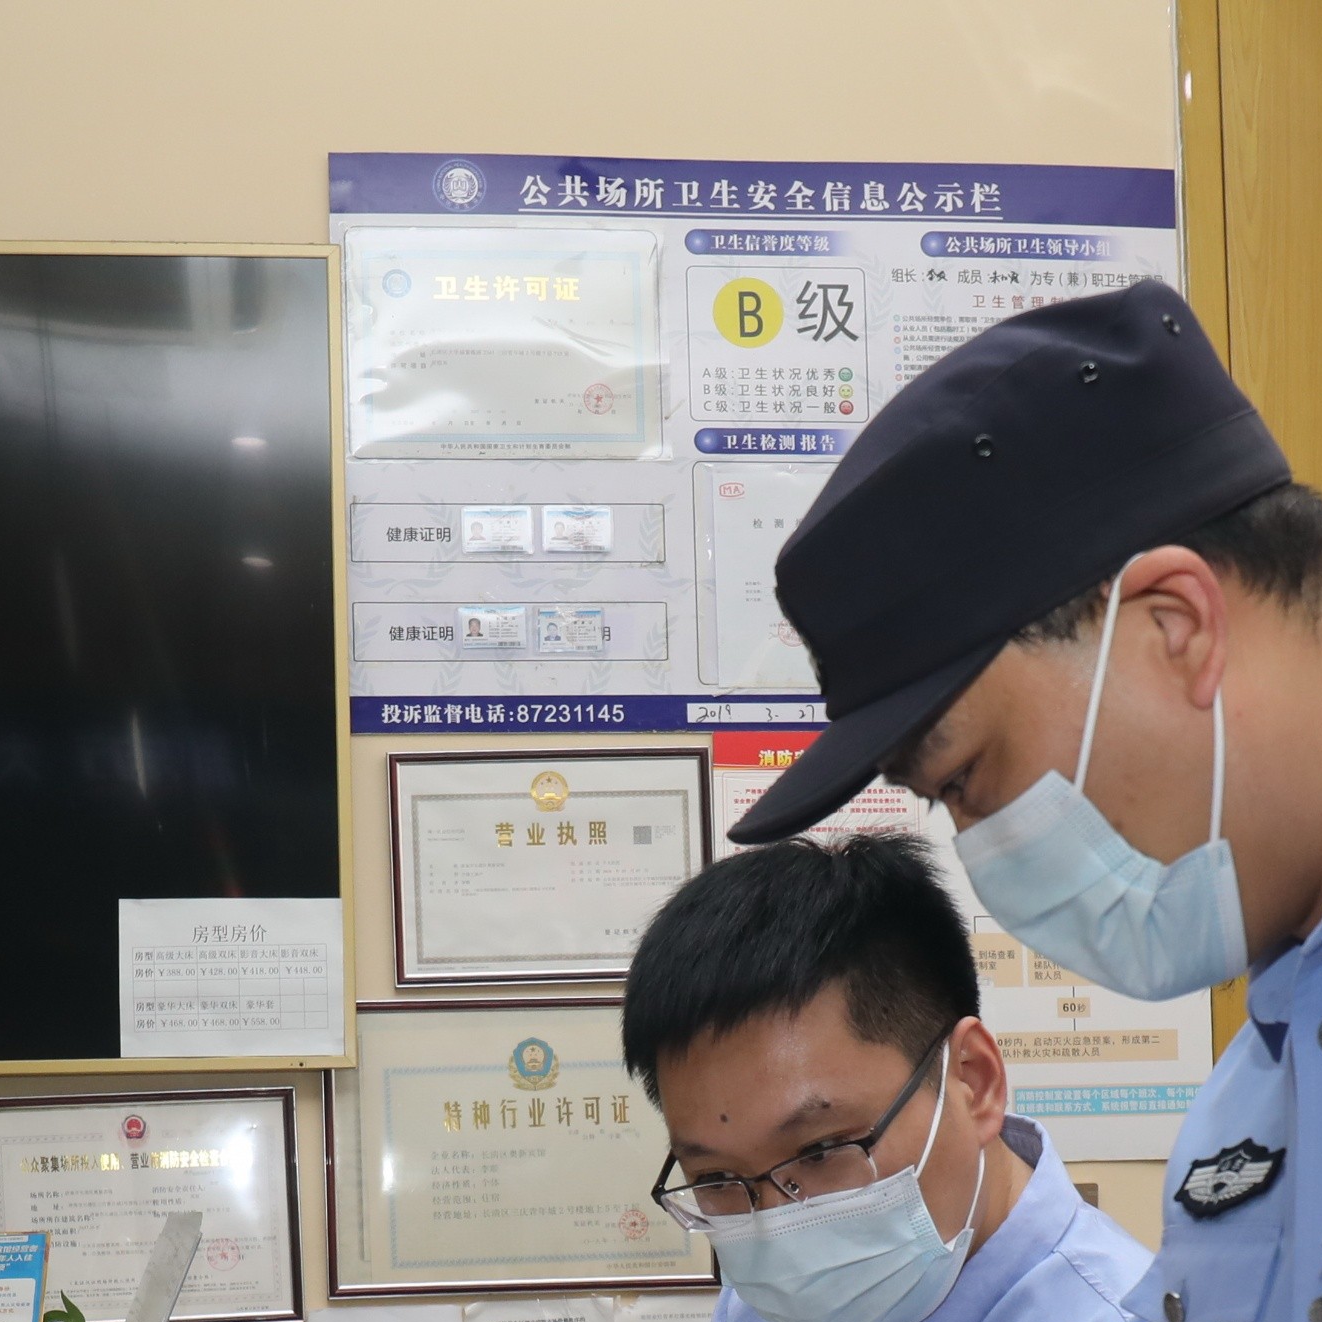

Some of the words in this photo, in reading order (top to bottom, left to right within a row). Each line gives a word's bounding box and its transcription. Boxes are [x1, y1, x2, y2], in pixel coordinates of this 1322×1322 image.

[519, 174, 1003, 213] 公共场所卫生安全信息公示栏
[711, 233, 830, 253] 卫生信誉度等级
[945, 236, 1111, 257] 公共场所卫生领导小组
[433, 275, 580, 302] 卫生许可证
[737, 291, 764, 339] B
[795, 281, 859, 343] 级
[723, 433, 835, 452] 卫生检测报告
[386, 526, 452, 543] 健康证明
[389, 625, 454, 642] 健康证明
[382, 703, 625, 725] 投诉监督电话:87231145
[495, 820, 608, 847] 营业执照
[192, 925, 268, 943] 房型房价
[134, 952, 155, 961] 房型
[280, 950, 319, 959] 影音双床
[978, 949, 1015, 960] 到场查看
[134, 969, 154, 979] 房价
[975, 961, 997, 971] 制室
[1034, 970, 1063, 981] 散人员
[135, 1002, 155, 1011] 房型
[1062, 1003, 1086, 1013] 60秒
[136, 1020, 156, 1029] 房价
[442, 1095, 631, 1133] 特种行业许可证
